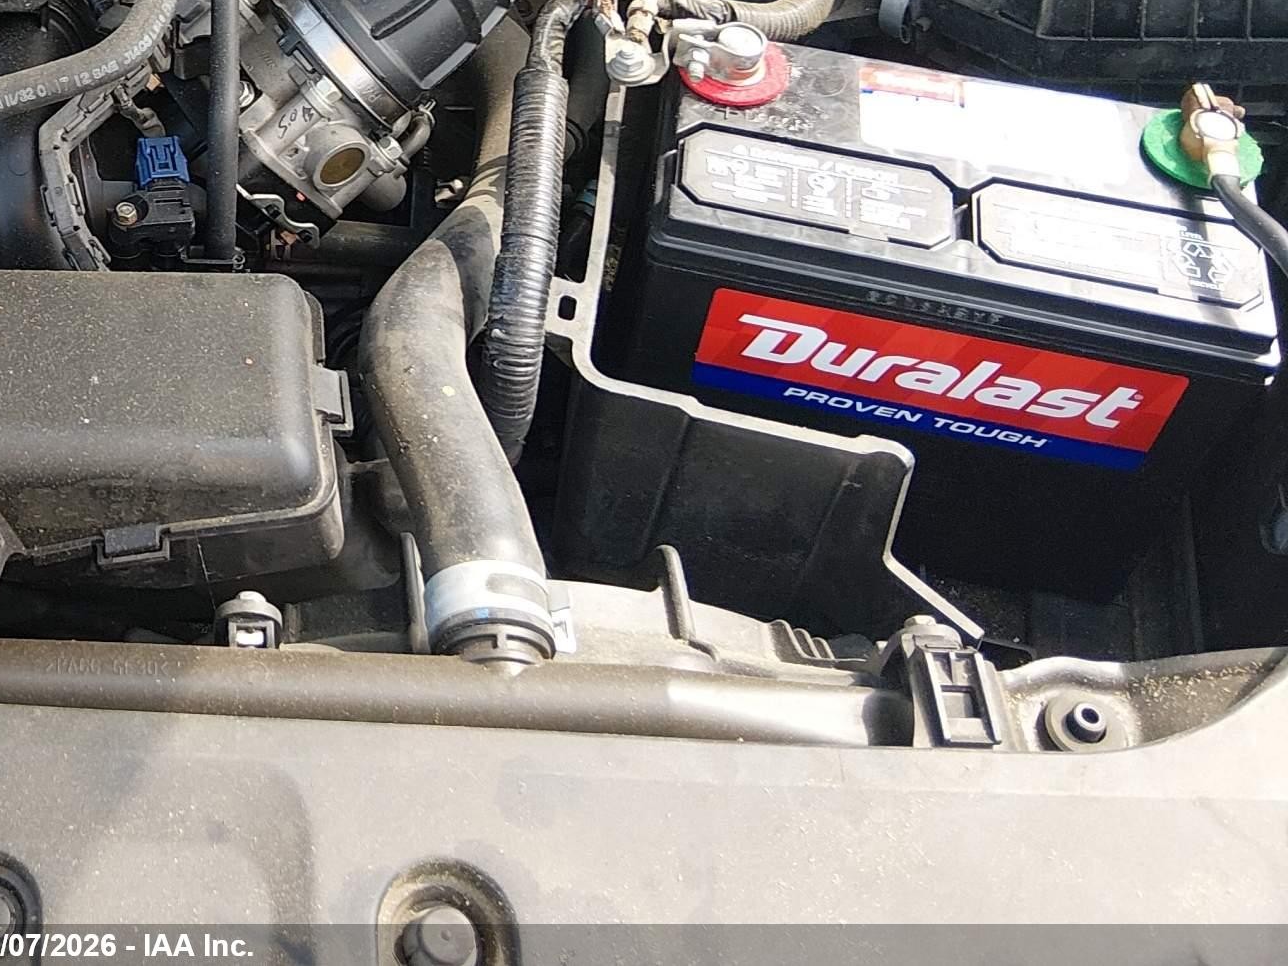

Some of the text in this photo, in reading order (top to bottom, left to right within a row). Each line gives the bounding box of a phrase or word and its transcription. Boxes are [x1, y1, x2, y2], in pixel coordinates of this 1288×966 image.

[92, 60, 119, 79] SAE
[738, 314, 1142, 429] Duralast
[783, 387, 1048, 448] PROVEN TOUGH
